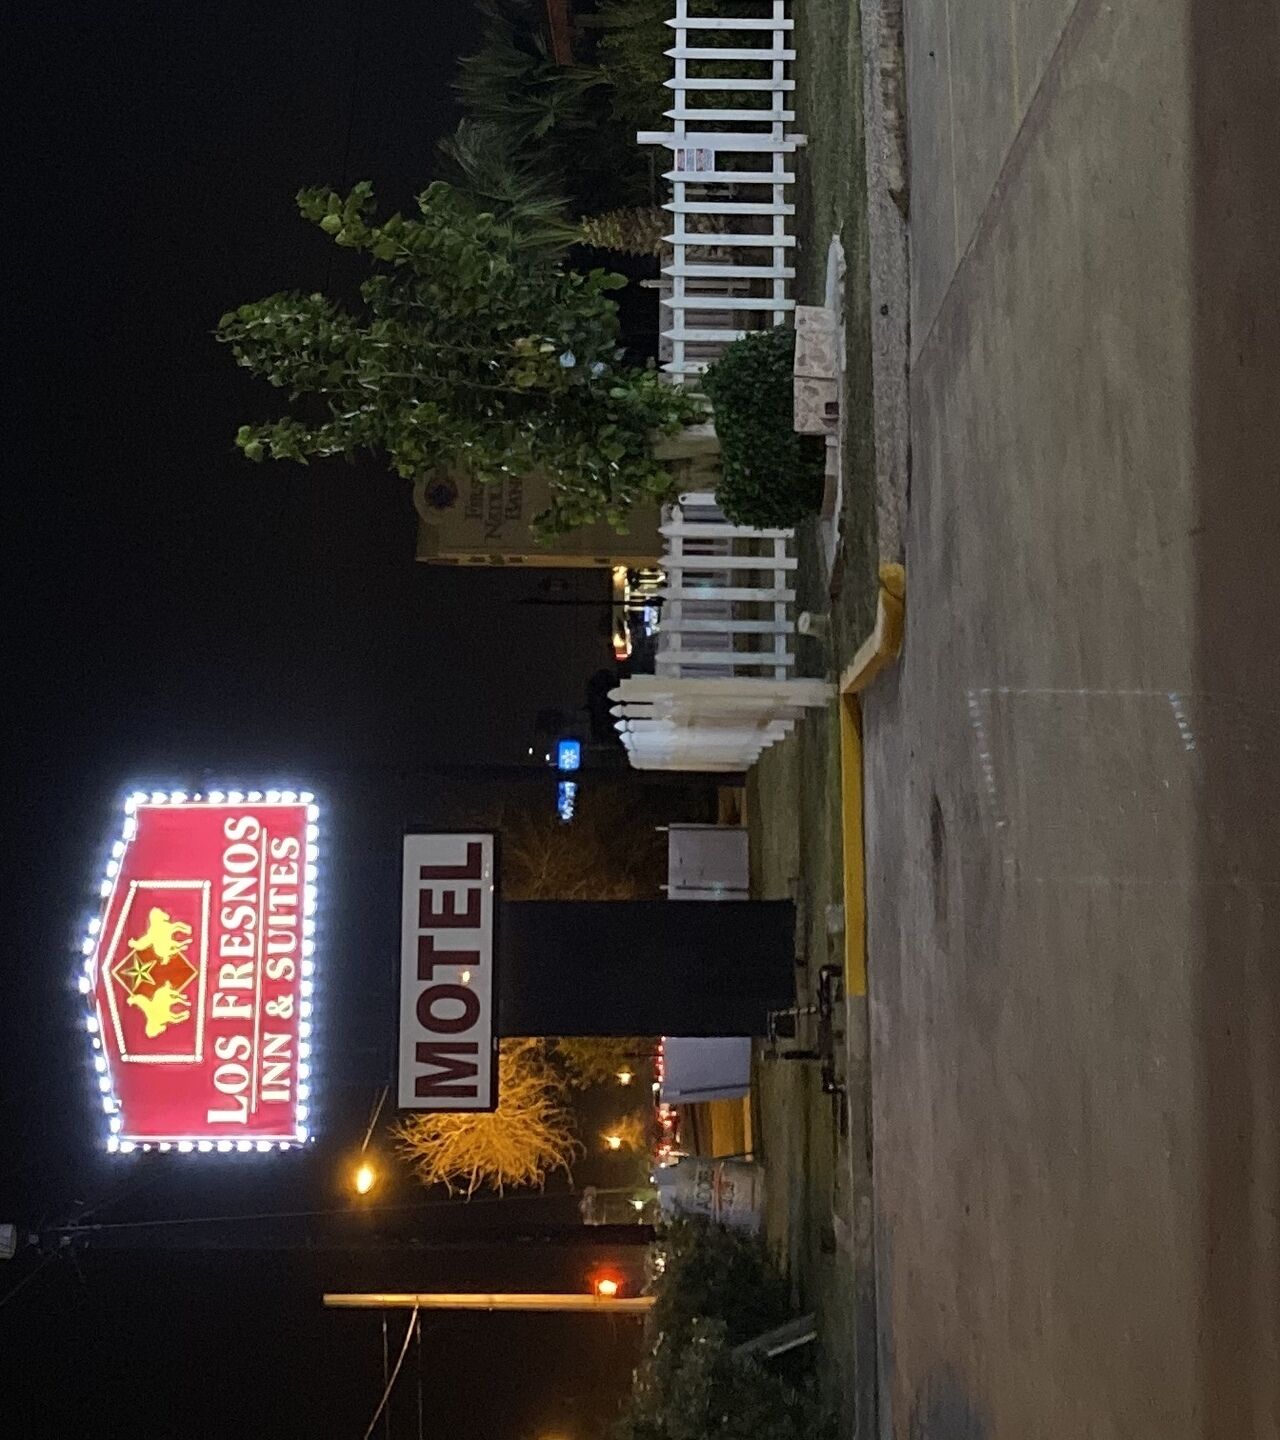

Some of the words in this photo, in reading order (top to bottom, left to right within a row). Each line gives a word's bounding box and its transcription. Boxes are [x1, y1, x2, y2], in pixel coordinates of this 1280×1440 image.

[212, 815, 262, 1019] FRESNOS
[267, 836, 301, 981] SUITES
[265, 995, 296, 1019] &
[414, 842, 483, 1098] MOTEL
[207, 1035, 251, 1124] LOS
[261, 1032, 293, 1102] INN
